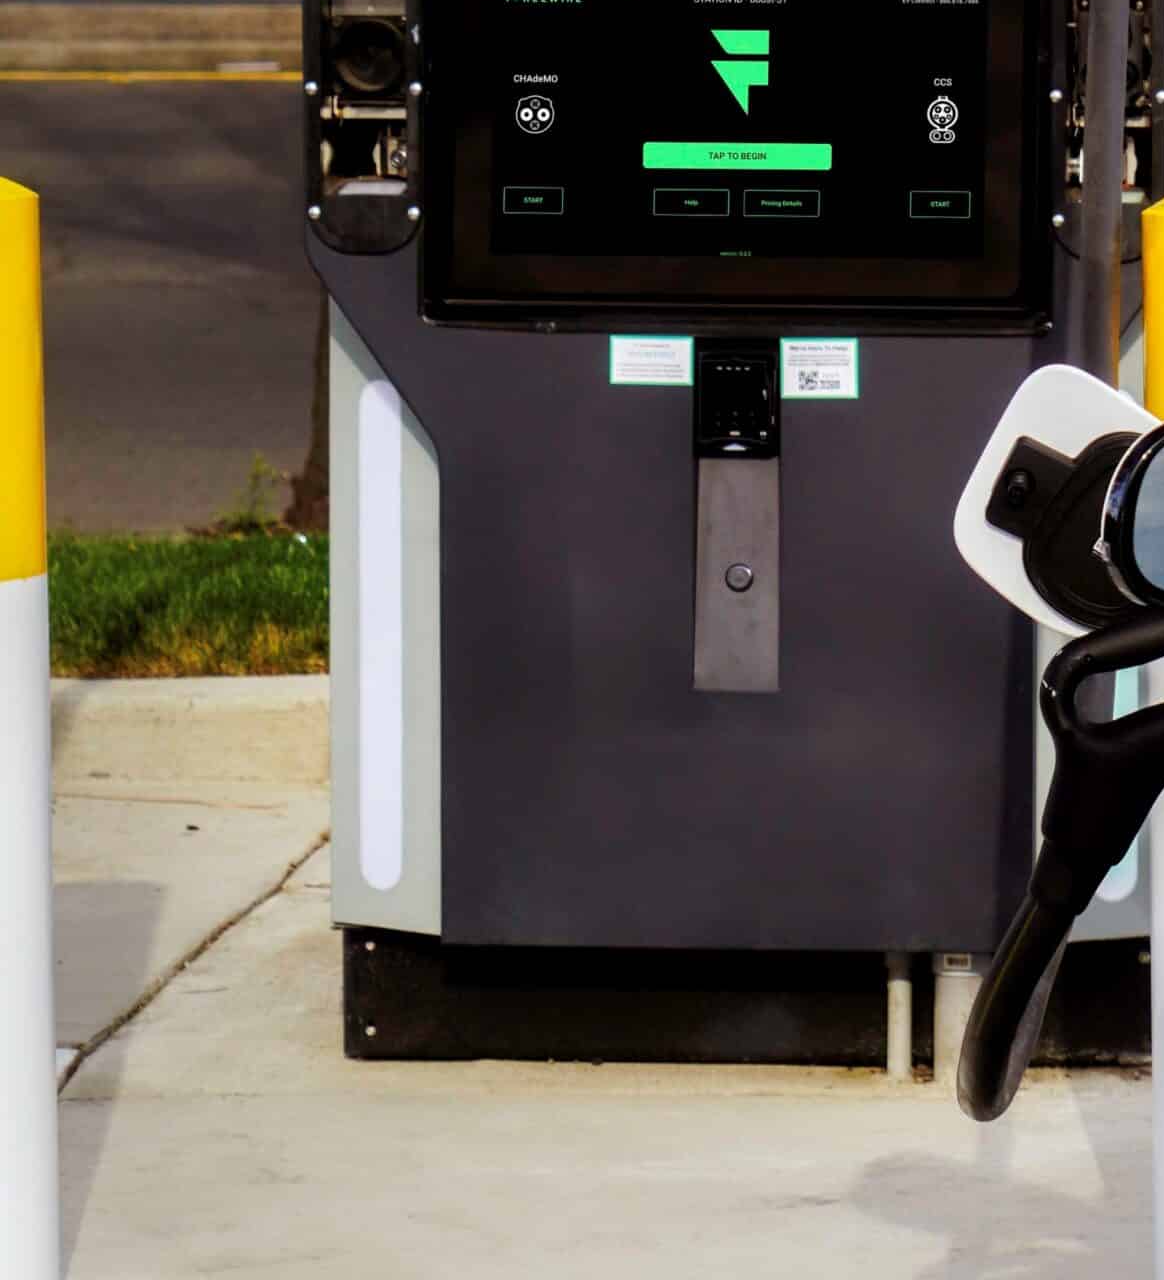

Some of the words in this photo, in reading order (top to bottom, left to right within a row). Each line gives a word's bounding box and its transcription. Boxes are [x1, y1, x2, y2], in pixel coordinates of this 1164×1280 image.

[513, 74, 559, 83] CHAdeMO
[933, 77, 953, 87] CCS
[708, 151, 725, 160] TAP
[727, 151, 740, 161] TO
[740, 152, 767, 161] BEGIN
[523, 196, 544, 204] START
[683, 199, 699, 208] Help
[930, 200, 950, 208] START
